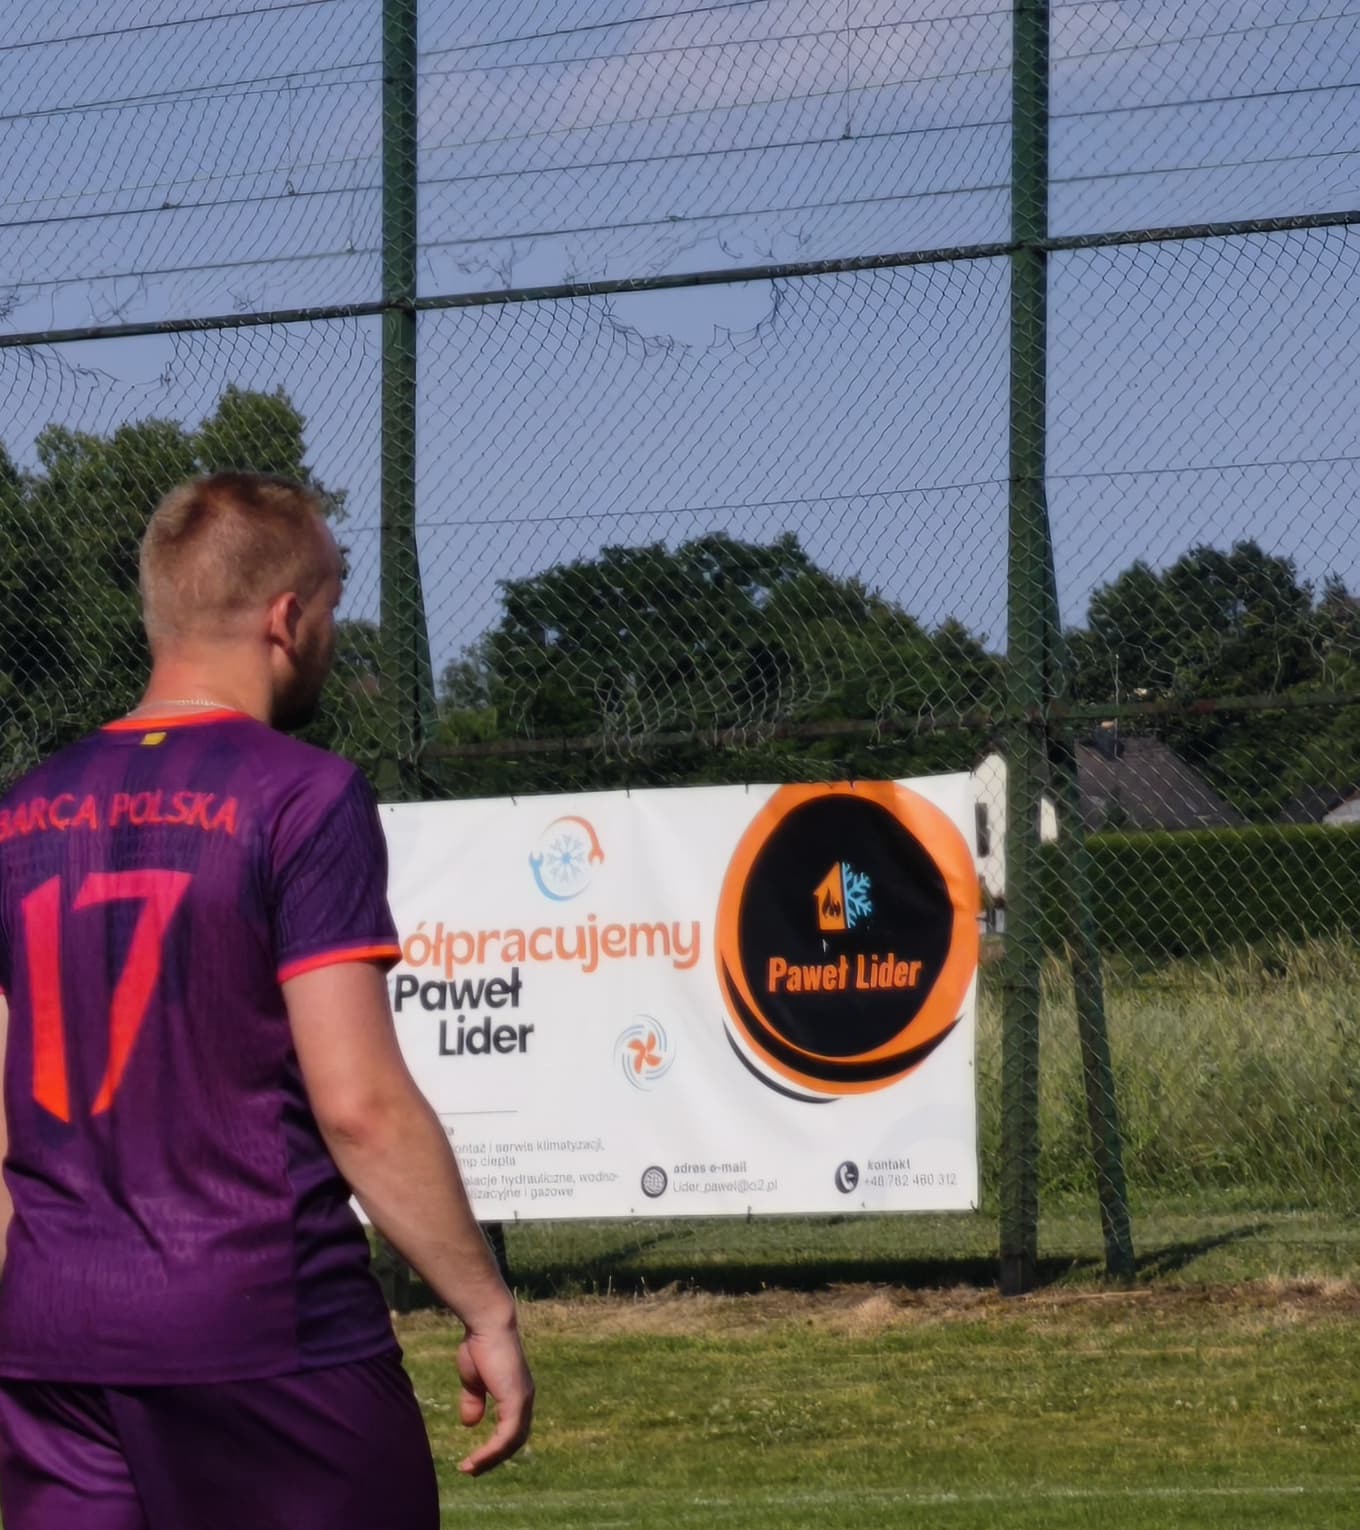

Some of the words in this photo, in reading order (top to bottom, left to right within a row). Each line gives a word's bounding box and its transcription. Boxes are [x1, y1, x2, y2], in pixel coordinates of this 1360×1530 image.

[110, 789, 240, 837] POLSKA
[401, 914, 701, 980] ółpracujemy
[393, 966, 523, 1012] Paweł
[768, 954, 849, 992] Paweł
[855, 952, 922, 990] Lider
[21, 869, 192, 1124] 17
[438, 1014, 535, 1056] Lider
[867, 1158, 911, 1171] kontakt
